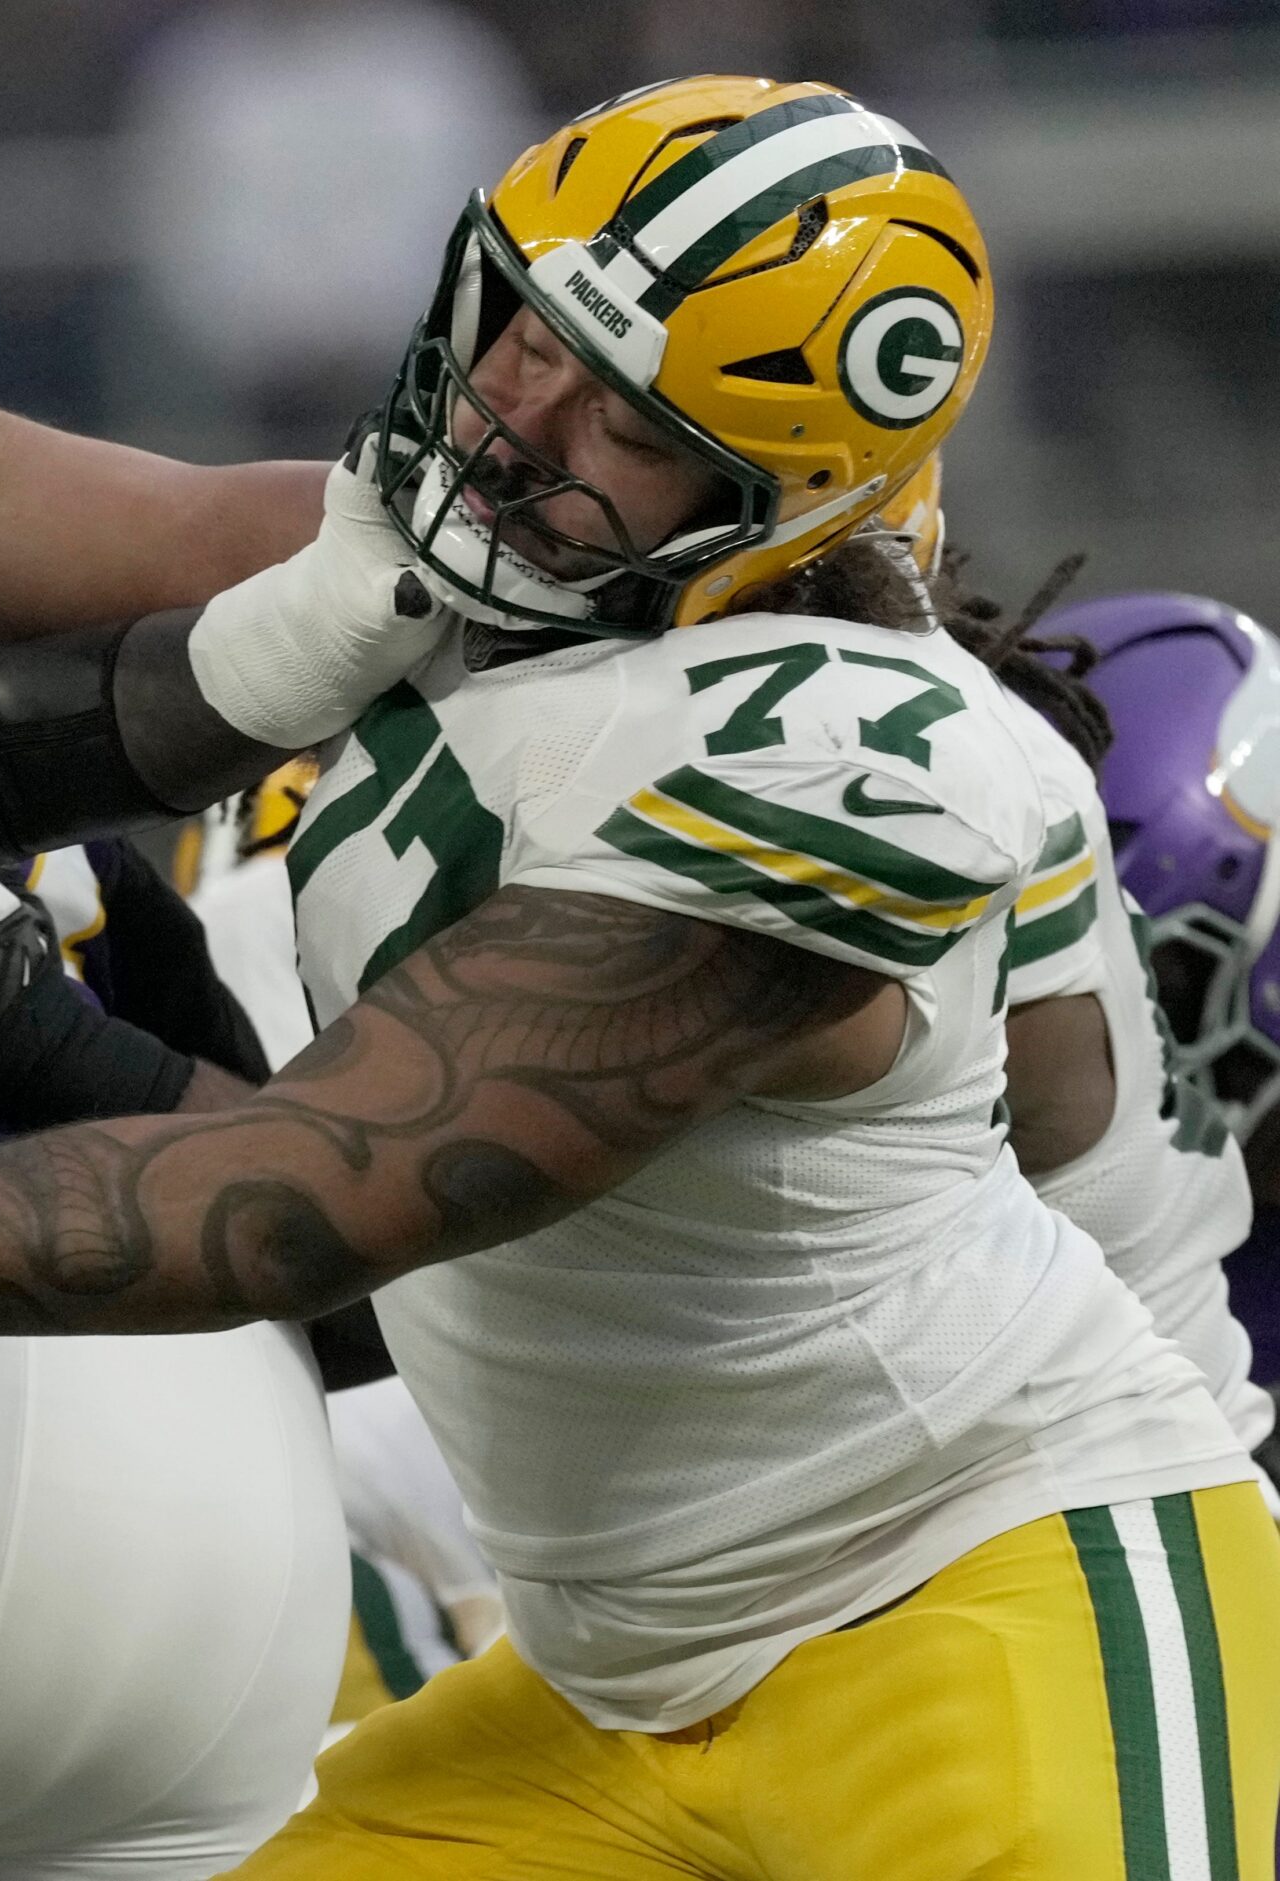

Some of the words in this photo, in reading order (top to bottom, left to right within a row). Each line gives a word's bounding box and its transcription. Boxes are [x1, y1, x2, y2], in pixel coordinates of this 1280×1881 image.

[564, 269, 632, 339] PACKERS
[845, 296, 963, 420] G
[684, 642, 968, 772] 77
